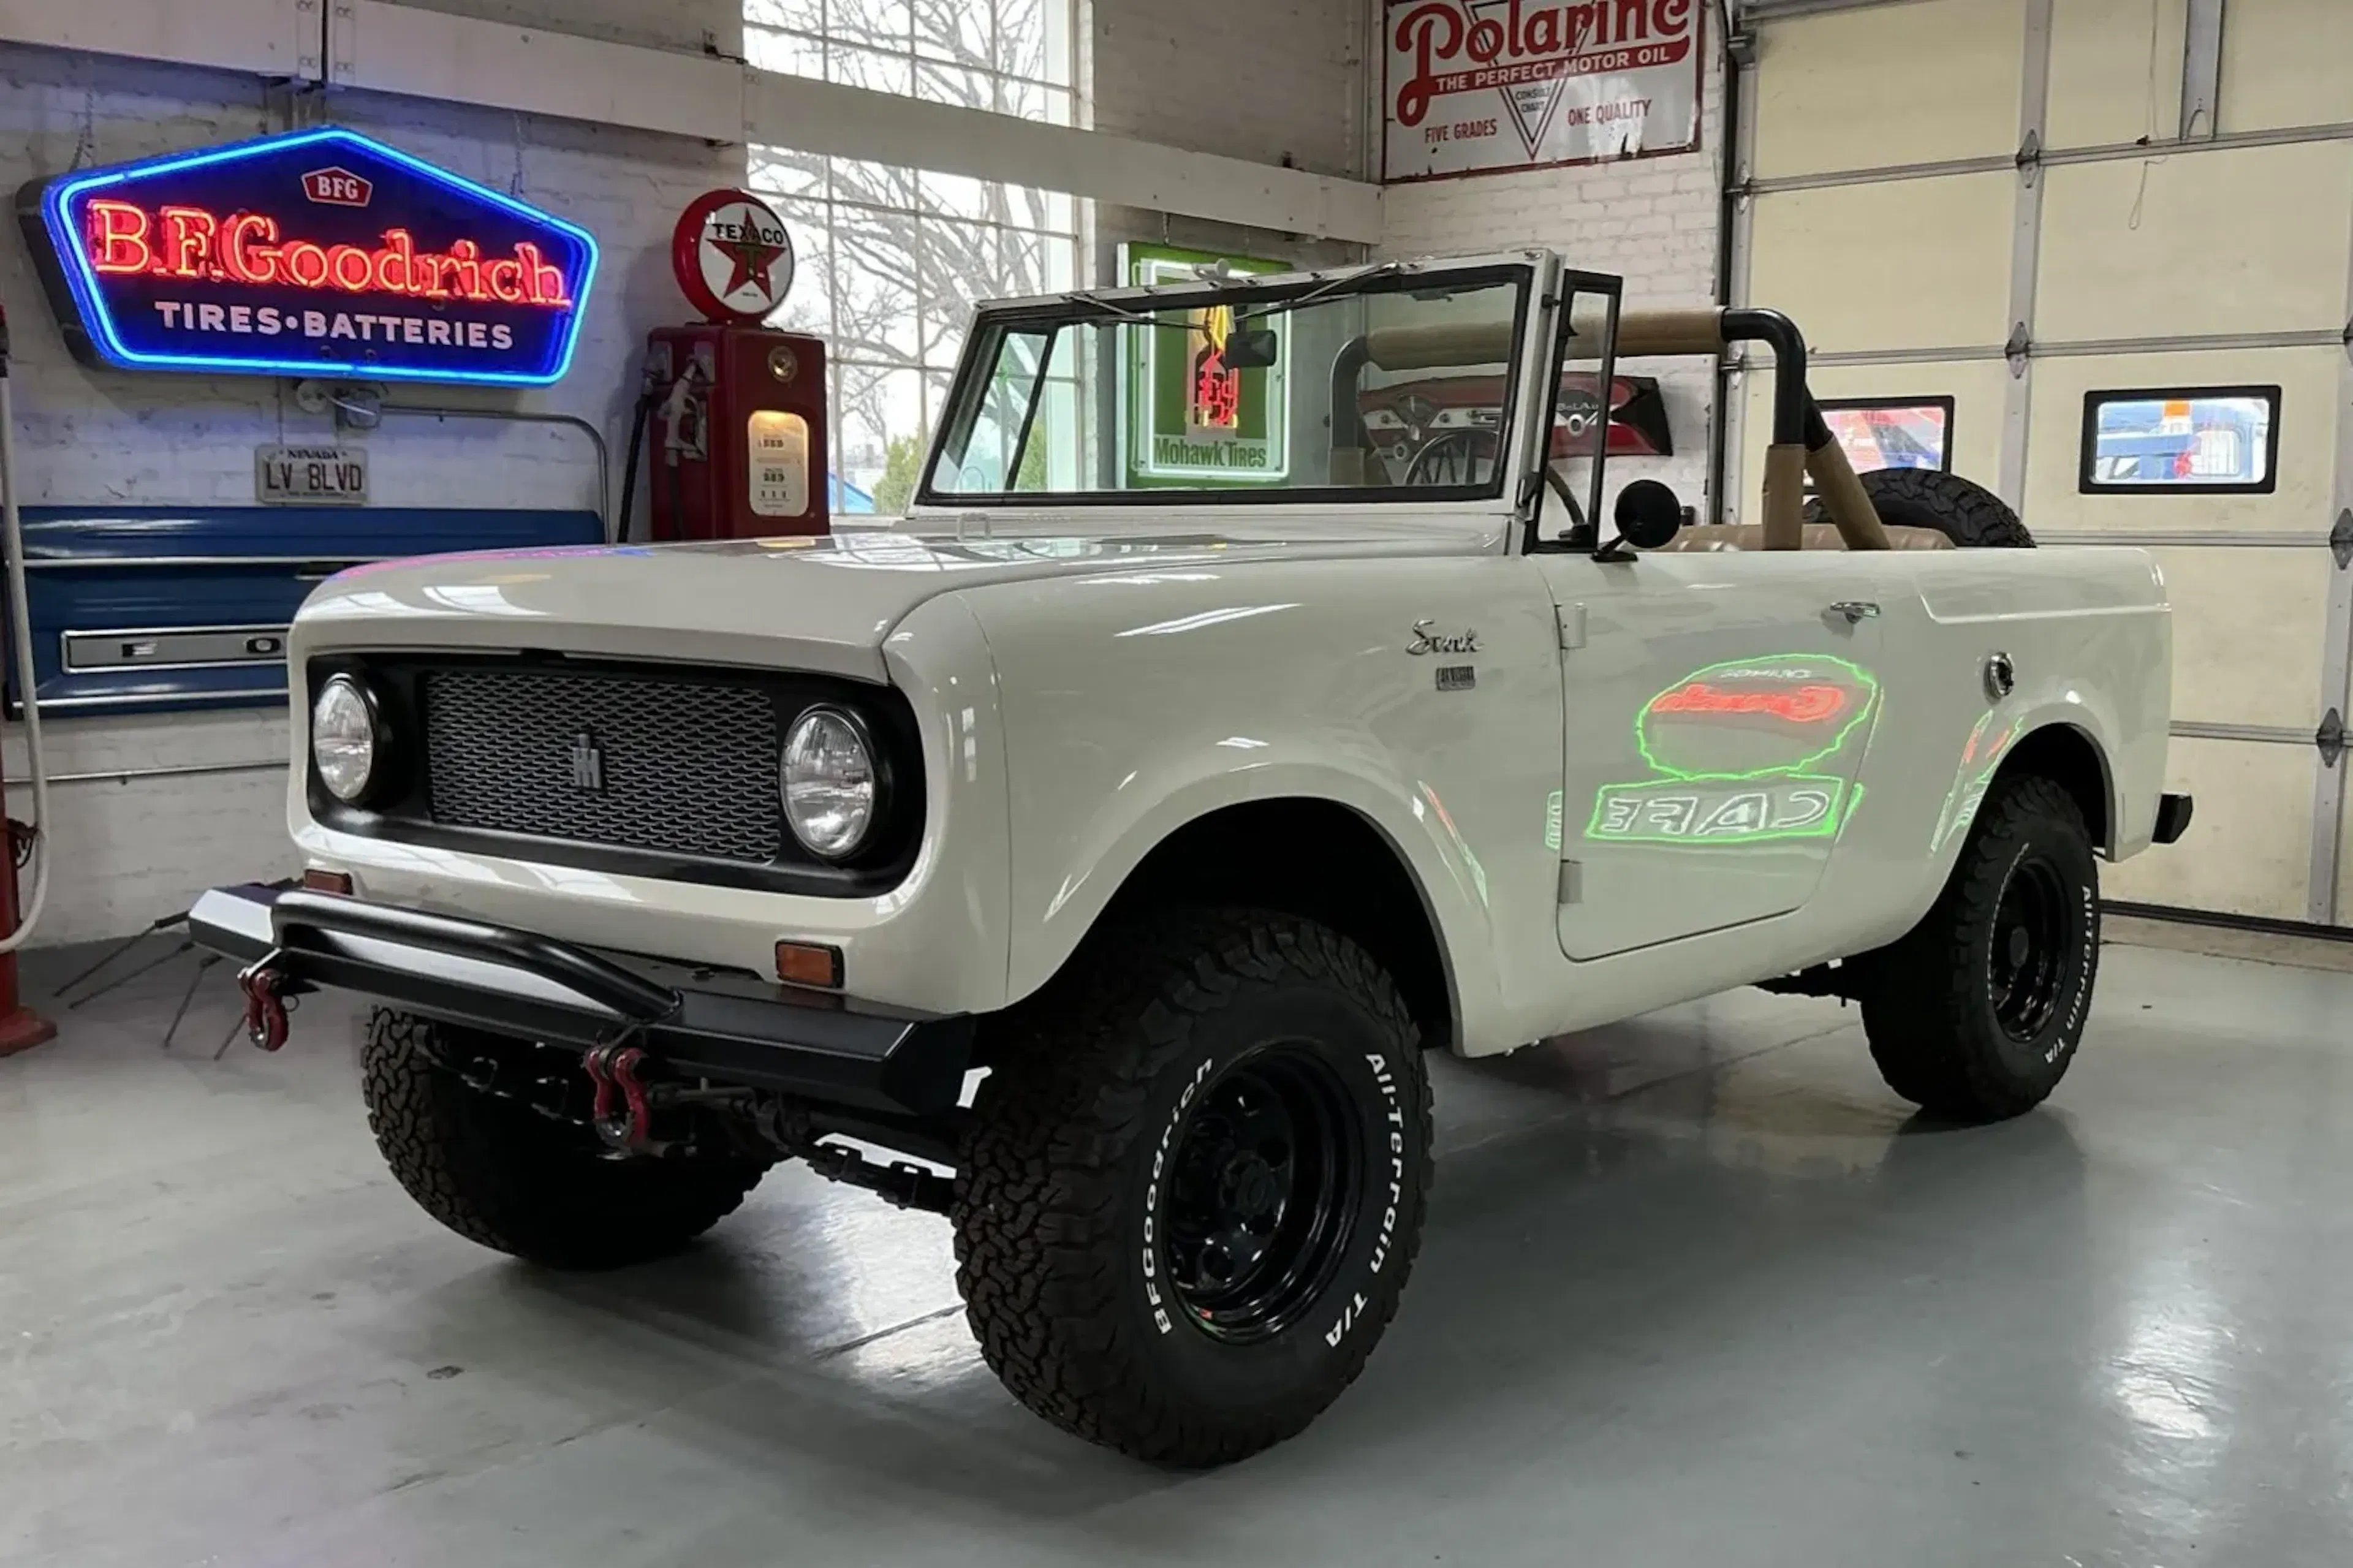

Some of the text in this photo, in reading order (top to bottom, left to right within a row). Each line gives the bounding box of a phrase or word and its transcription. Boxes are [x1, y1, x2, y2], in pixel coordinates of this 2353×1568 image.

[1395, 0, 1689, 126] Polarine
[1436, 47, 1671, 92] THE PERFECT MOTOR OIL
[1567, 99, 1653, 127] ONE QUALITY
[1424, 119, 1498, 144] FIVE GRADES
[317, 175, 358, 199] BFG
[713, 224, 784, 244] TEXACO
[287, 448, 339, 460] NEVADA
[1153, 437, 1227, 467] Mohawk
[266, 463, 362, 492] LV BLVD
[2044, 1037, 2066, 1064] T/A
[1325, 1290, 1368, 1348] T/A
